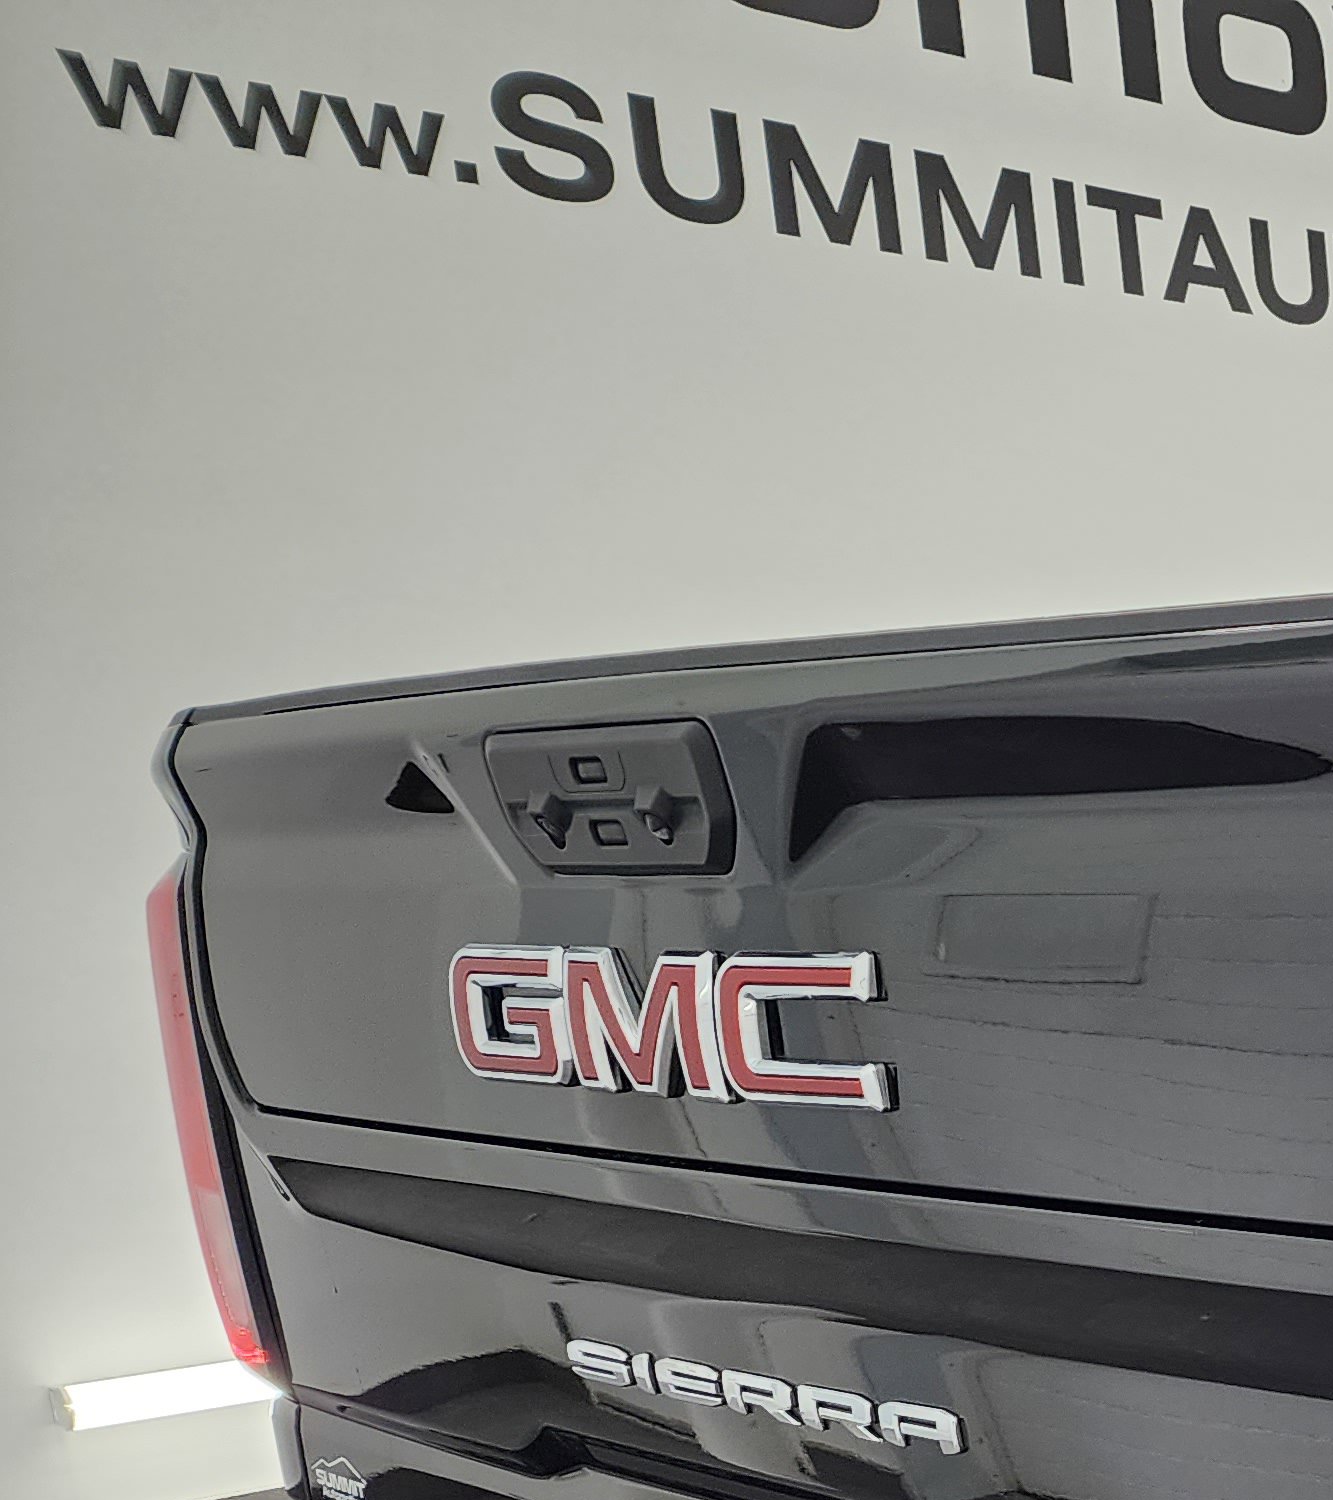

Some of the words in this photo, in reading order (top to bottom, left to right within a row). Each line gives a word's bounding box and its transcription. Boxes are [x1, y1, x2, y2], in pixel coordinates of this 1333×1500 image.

[449, 943, 899, 1112] GMC
[567, 1337, 969, 1455] SIERRA
[315, 1468, 366, 1499] SUMMIT
